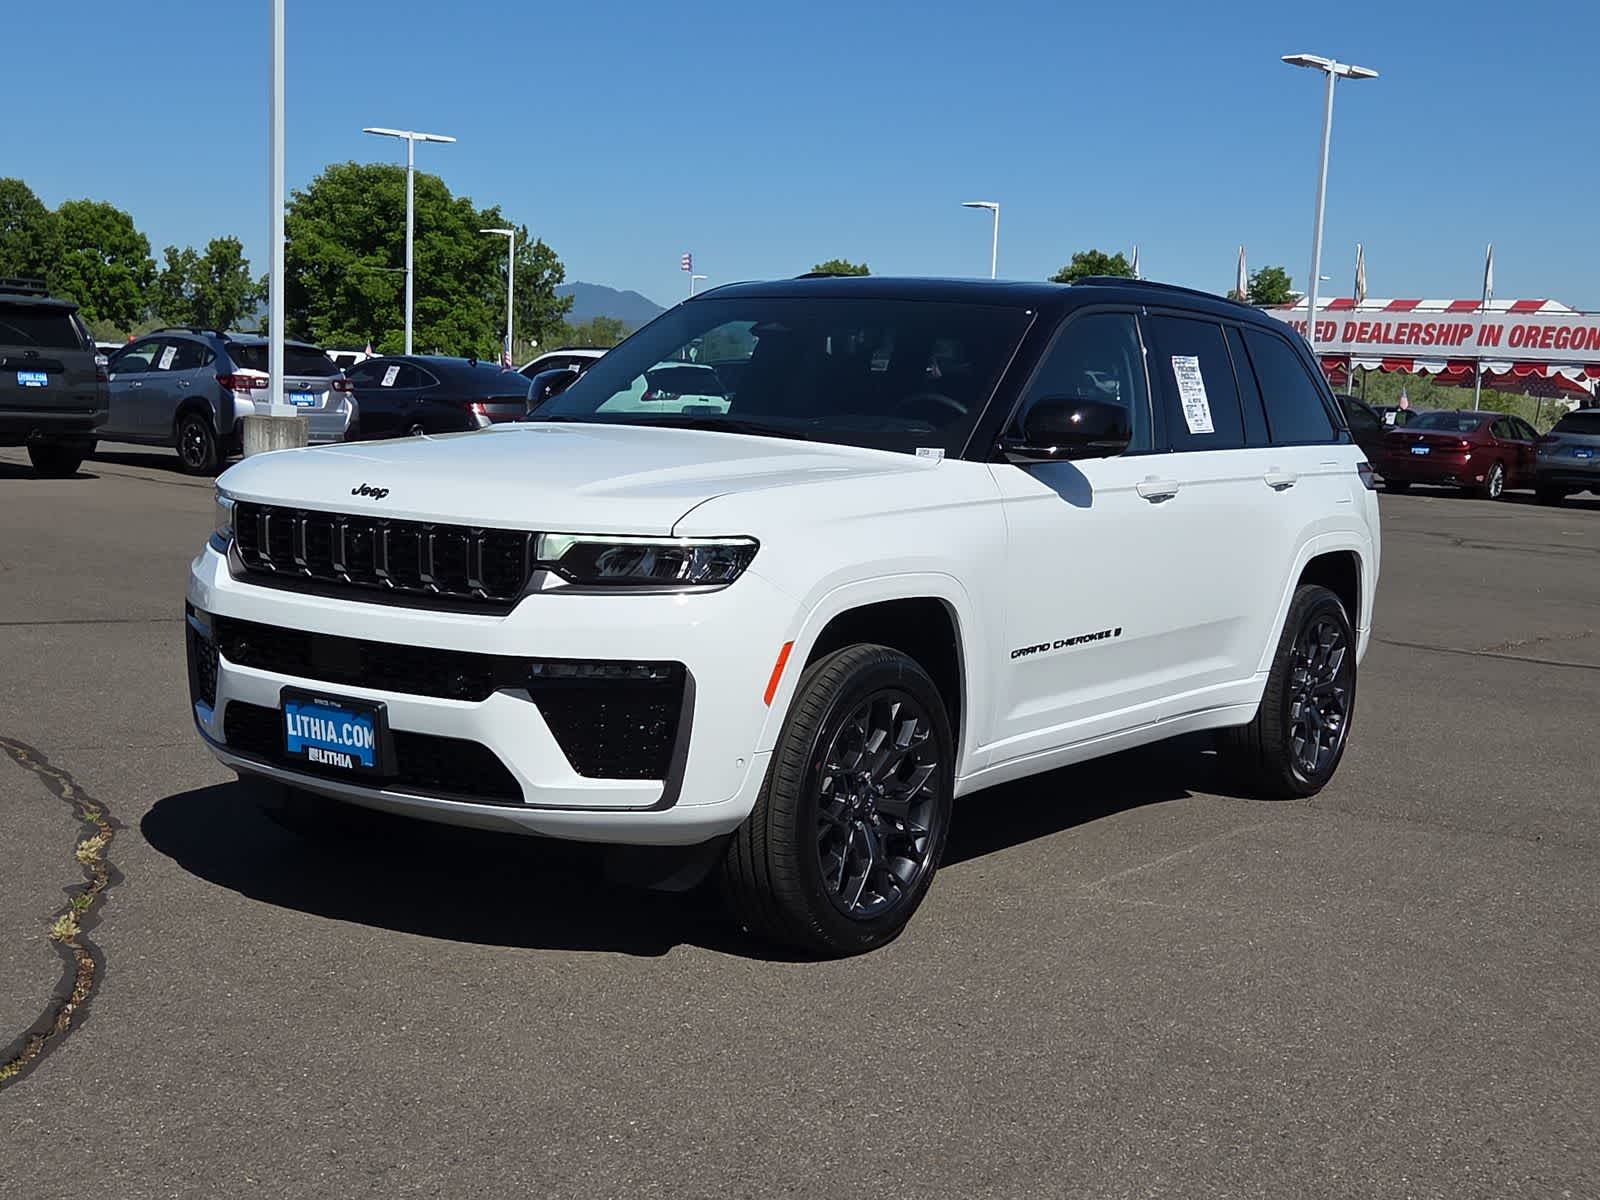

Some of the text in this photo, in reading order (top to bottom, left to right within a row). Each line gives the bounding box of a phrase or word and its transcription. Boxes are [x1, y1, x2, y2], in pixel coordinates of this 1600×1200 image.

[1341, 320, 1474, 346] DEALERSHIP
[1477, 323, 1504, 347] IN
[1508, 324, 1600, 351] OREGON
[351, 482, 390, 501] Jeep
[1011, 630, 1112, 659] GRAND CHEROKEE
[286, 713, 376, 750] LITHIA.COM
[318, 749, 353, 769] LITHIA
